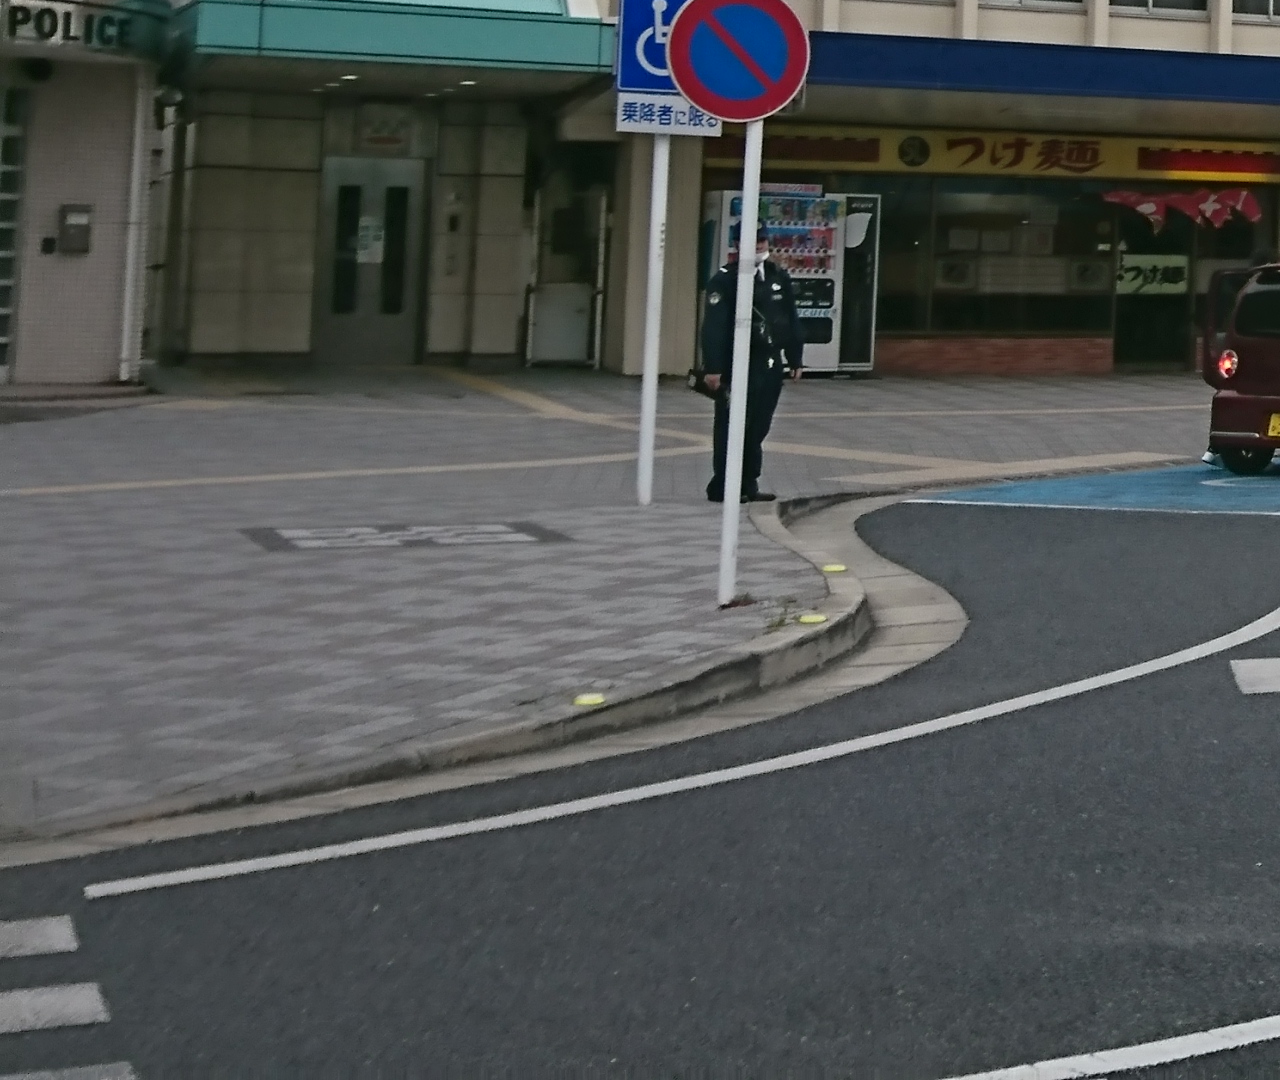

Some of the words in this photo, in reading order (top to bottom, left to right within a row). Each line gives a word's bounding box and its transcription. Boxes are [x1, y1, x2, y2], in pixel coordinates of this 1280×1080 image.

[8, 5, 131, 47] POLICE
[946, 136, 1105, 174] つけ麺
